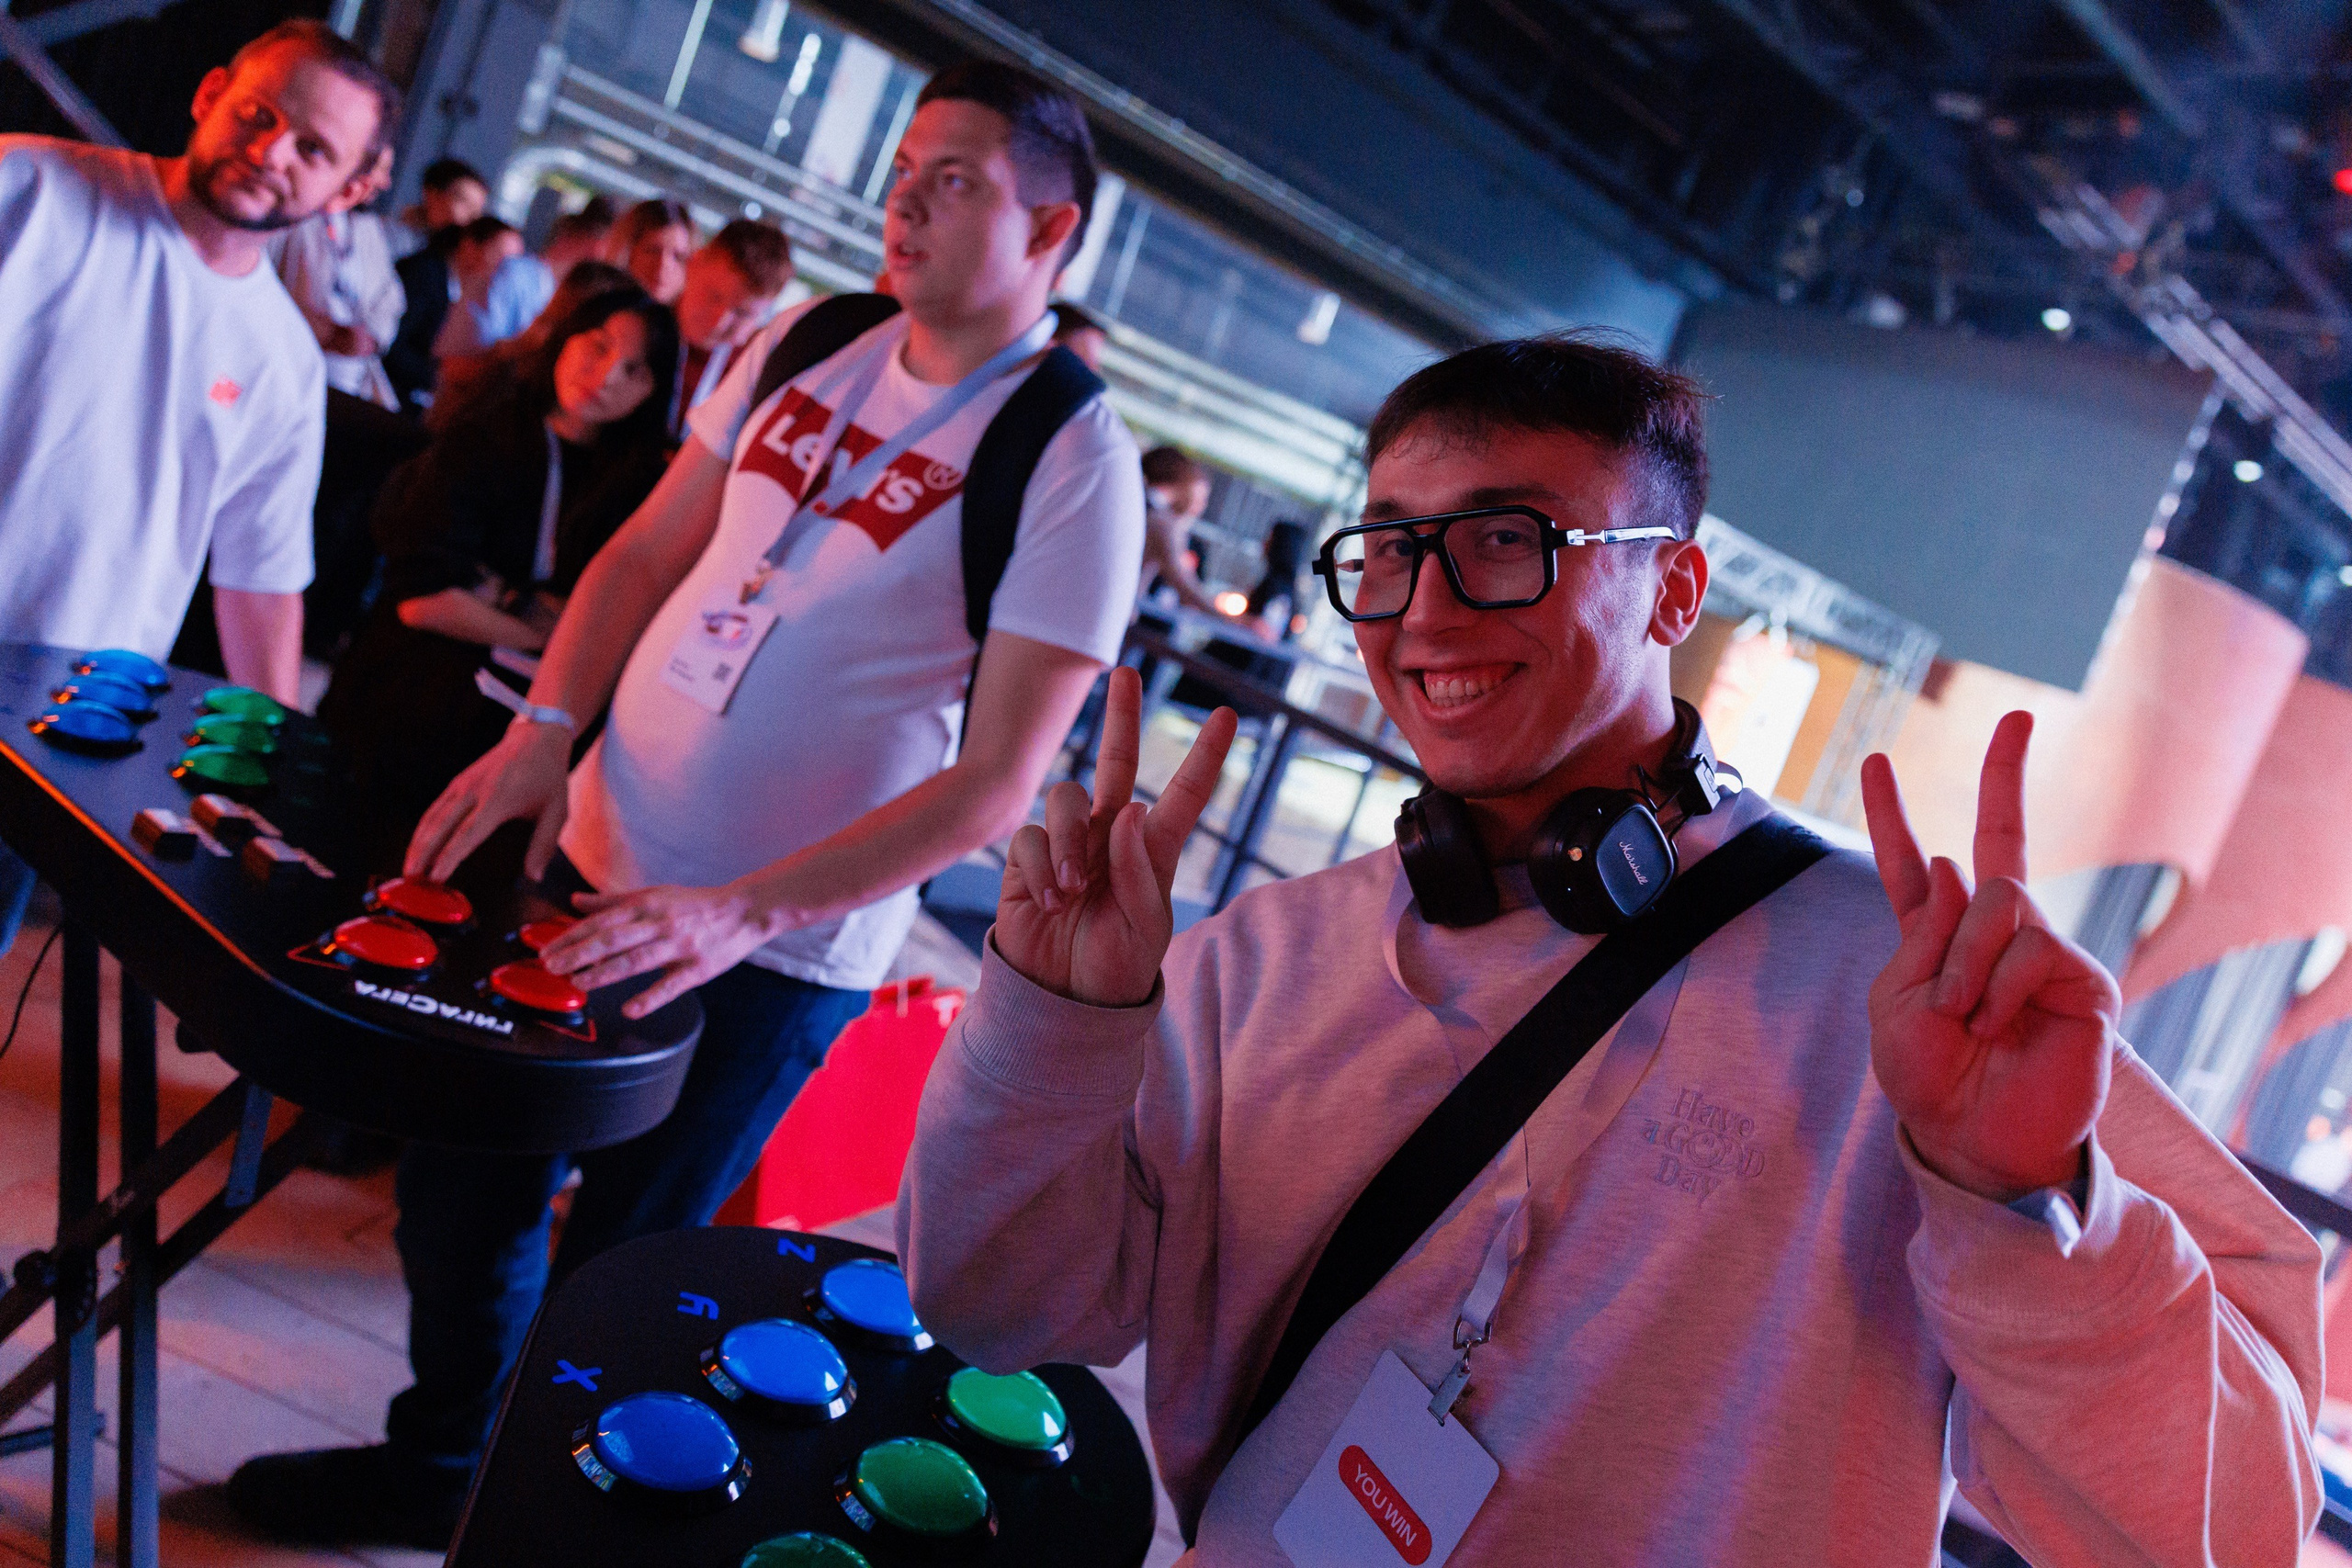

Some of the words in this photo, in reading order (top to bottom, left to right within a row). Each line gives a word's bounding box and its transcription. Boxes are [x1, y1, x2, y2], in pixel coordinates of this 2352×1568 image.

[1619, 840, 1649, 886] Marshall
[1670, 1087, 1755, 1138] Have
[1640, 1118, 1661, 1145] a
[1664, 1122, 1765, 1178] GOOD
[1654, 1154, 1722, 1209] Day
[1354, 1463, 1388, 1509] YOU
[1384, 1502, 1418, 1548] WIN
